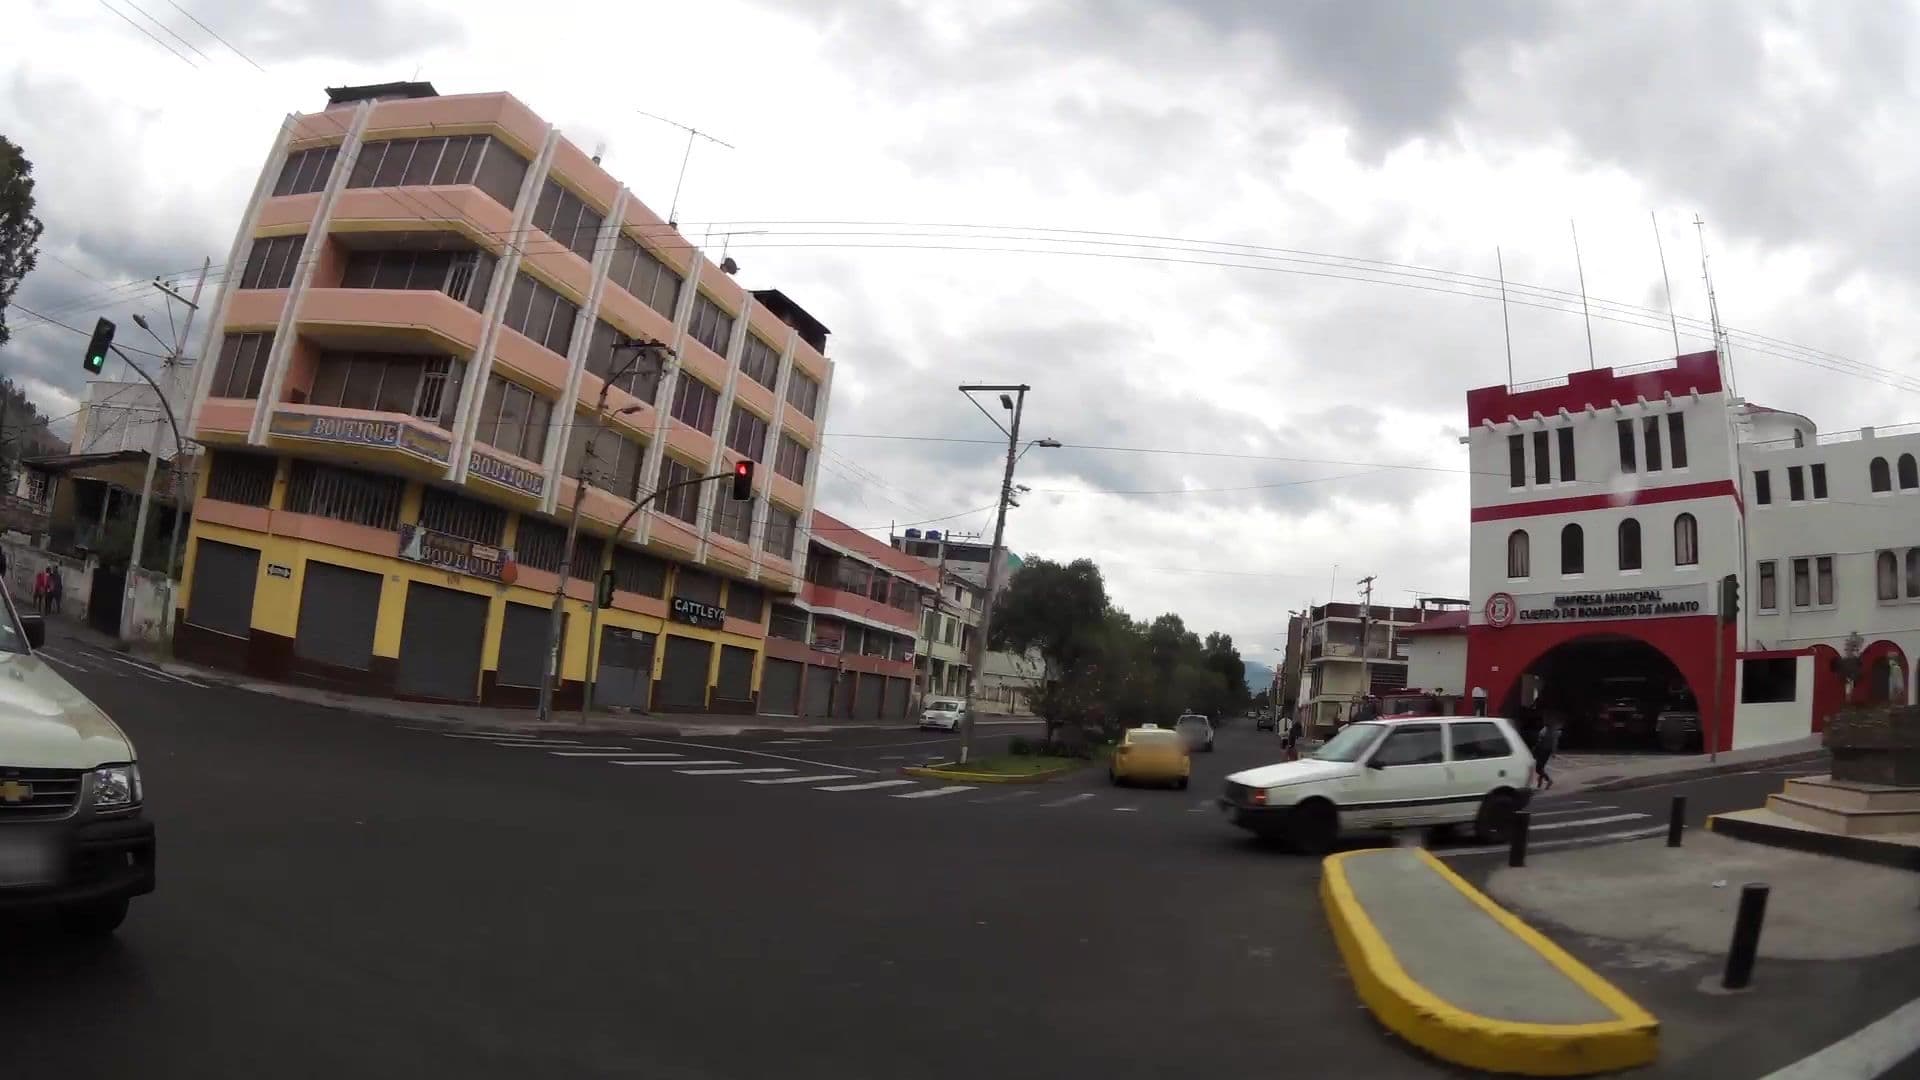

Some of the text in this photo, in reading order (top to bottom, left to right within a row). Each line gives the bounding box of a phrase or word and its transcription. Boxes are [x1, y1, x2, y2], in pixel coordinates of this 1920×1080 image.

[313, 418, 398, 442] BOUTIQUE
[469, 454, 542, 494] BOUTIQUE
[423, 546, 501, 578] BOUTIQUE
[1554, 590, 1663, 606] EMPRESA MUNICIPAL
[674, 599, 726, 622] CATTLEYA
[1519, 600, 1700, 620] CUERPO DE BOMBEROS DE AMBATO
